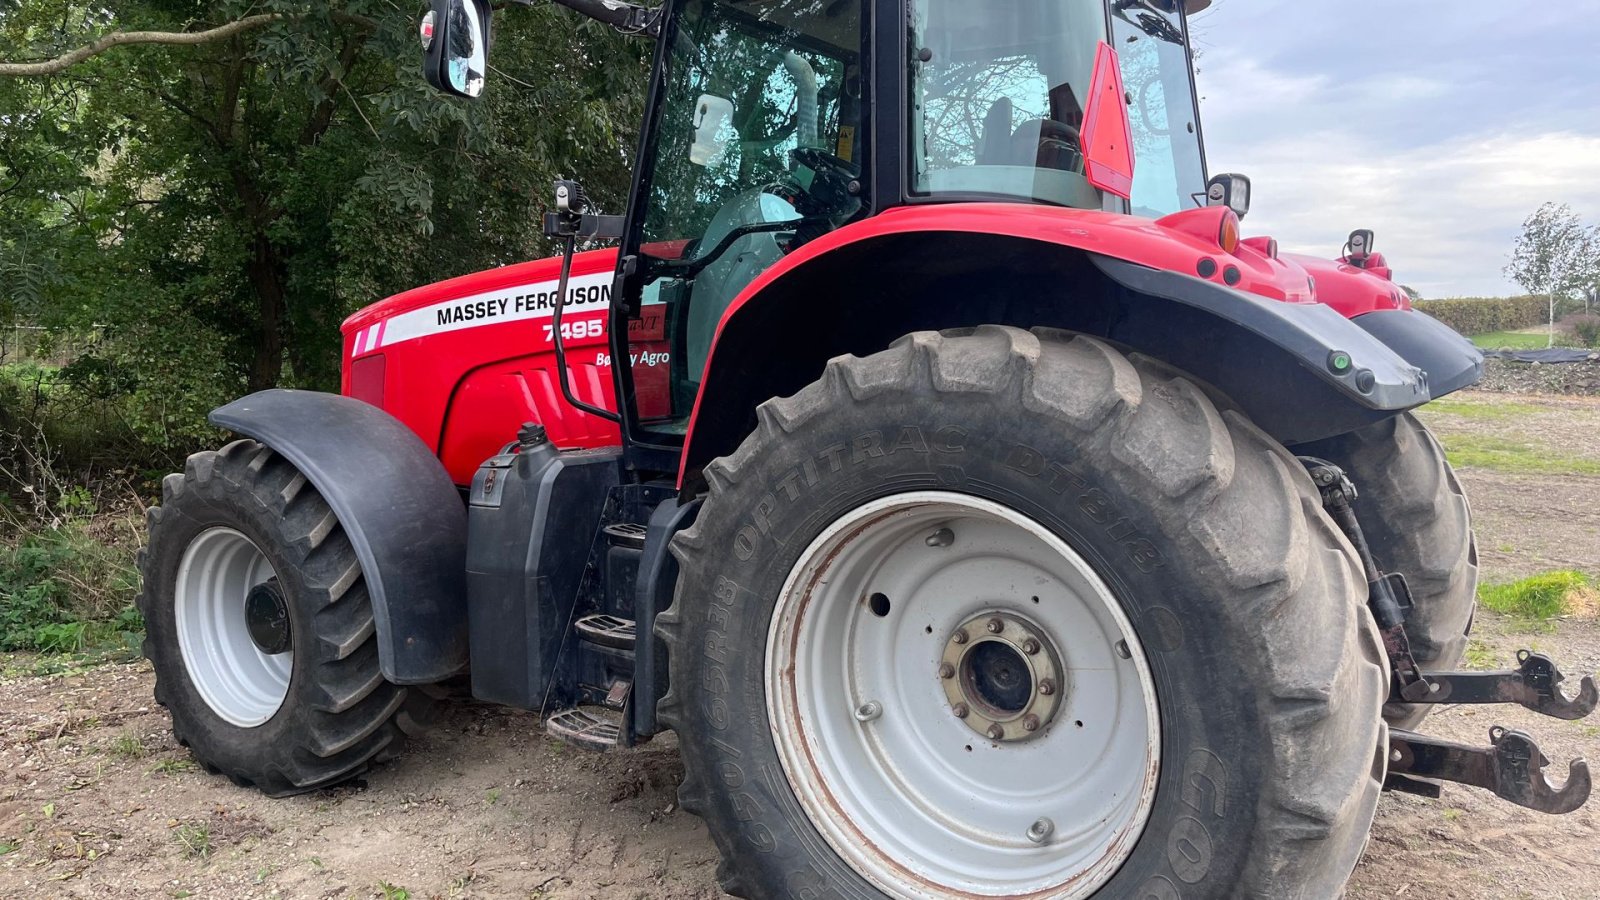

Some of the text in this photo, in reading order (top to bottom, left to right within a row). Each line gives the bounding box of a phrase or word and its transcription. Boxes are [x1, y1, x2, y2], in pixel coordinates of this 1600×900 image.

[437, 298, 508, 325] MASSEY
[542, 319, 603, 342] 7495
[640, 351, 670, 366] Agro
[734, 424, 969, 562] OPTITRAC
[702, 574, 777, 854] 650/65R38
